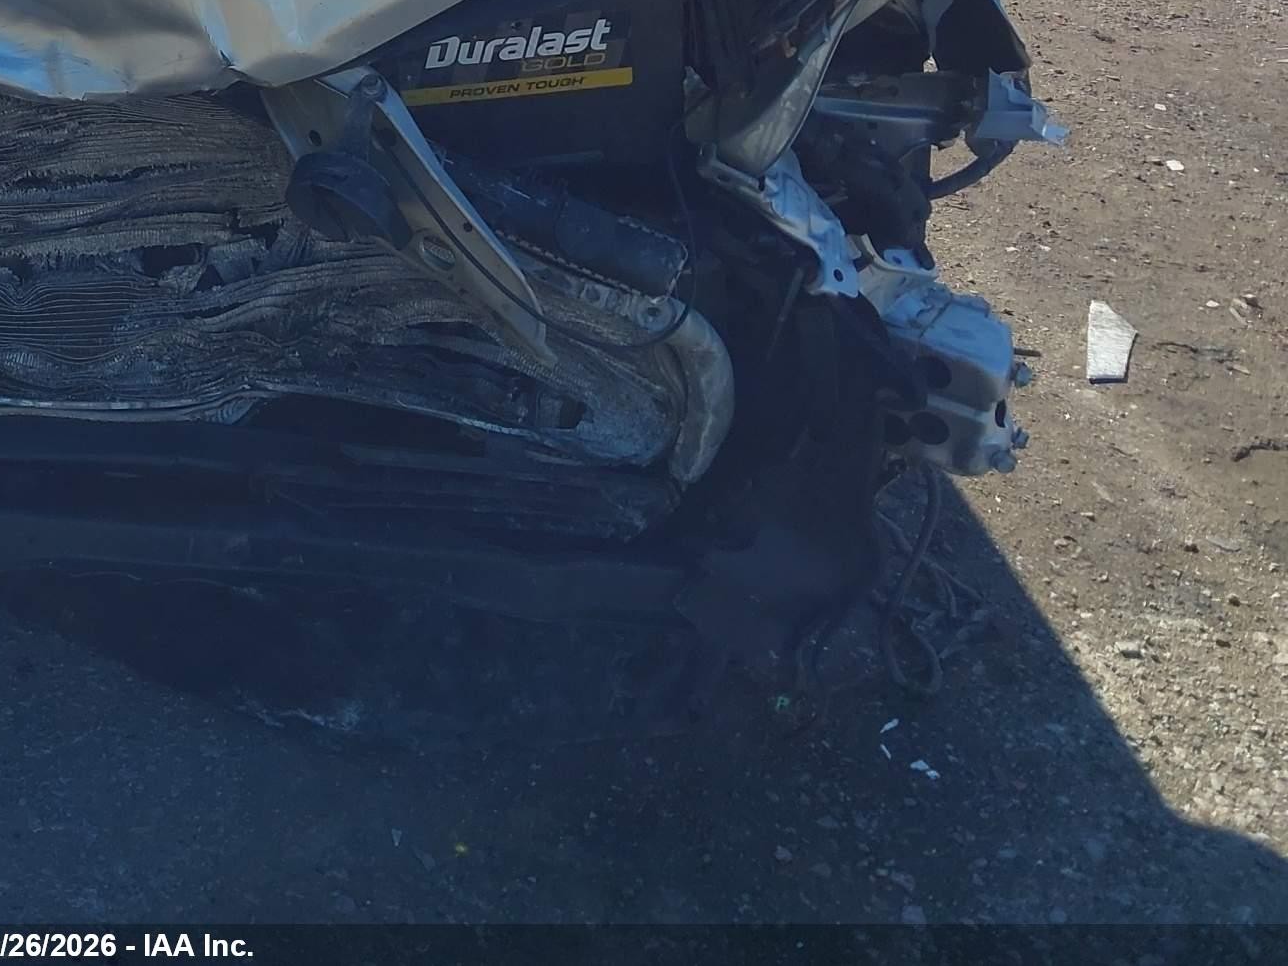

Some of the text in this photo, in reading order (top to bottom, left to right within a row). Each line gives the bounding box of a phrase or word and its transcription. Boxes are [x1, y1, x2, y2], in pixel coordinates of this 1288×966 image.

[425, 19, 611, 69] Duralast
[521, 52, 605, 72] GOLD
[449, 76, 585, 98] PROVEN TOUGH
